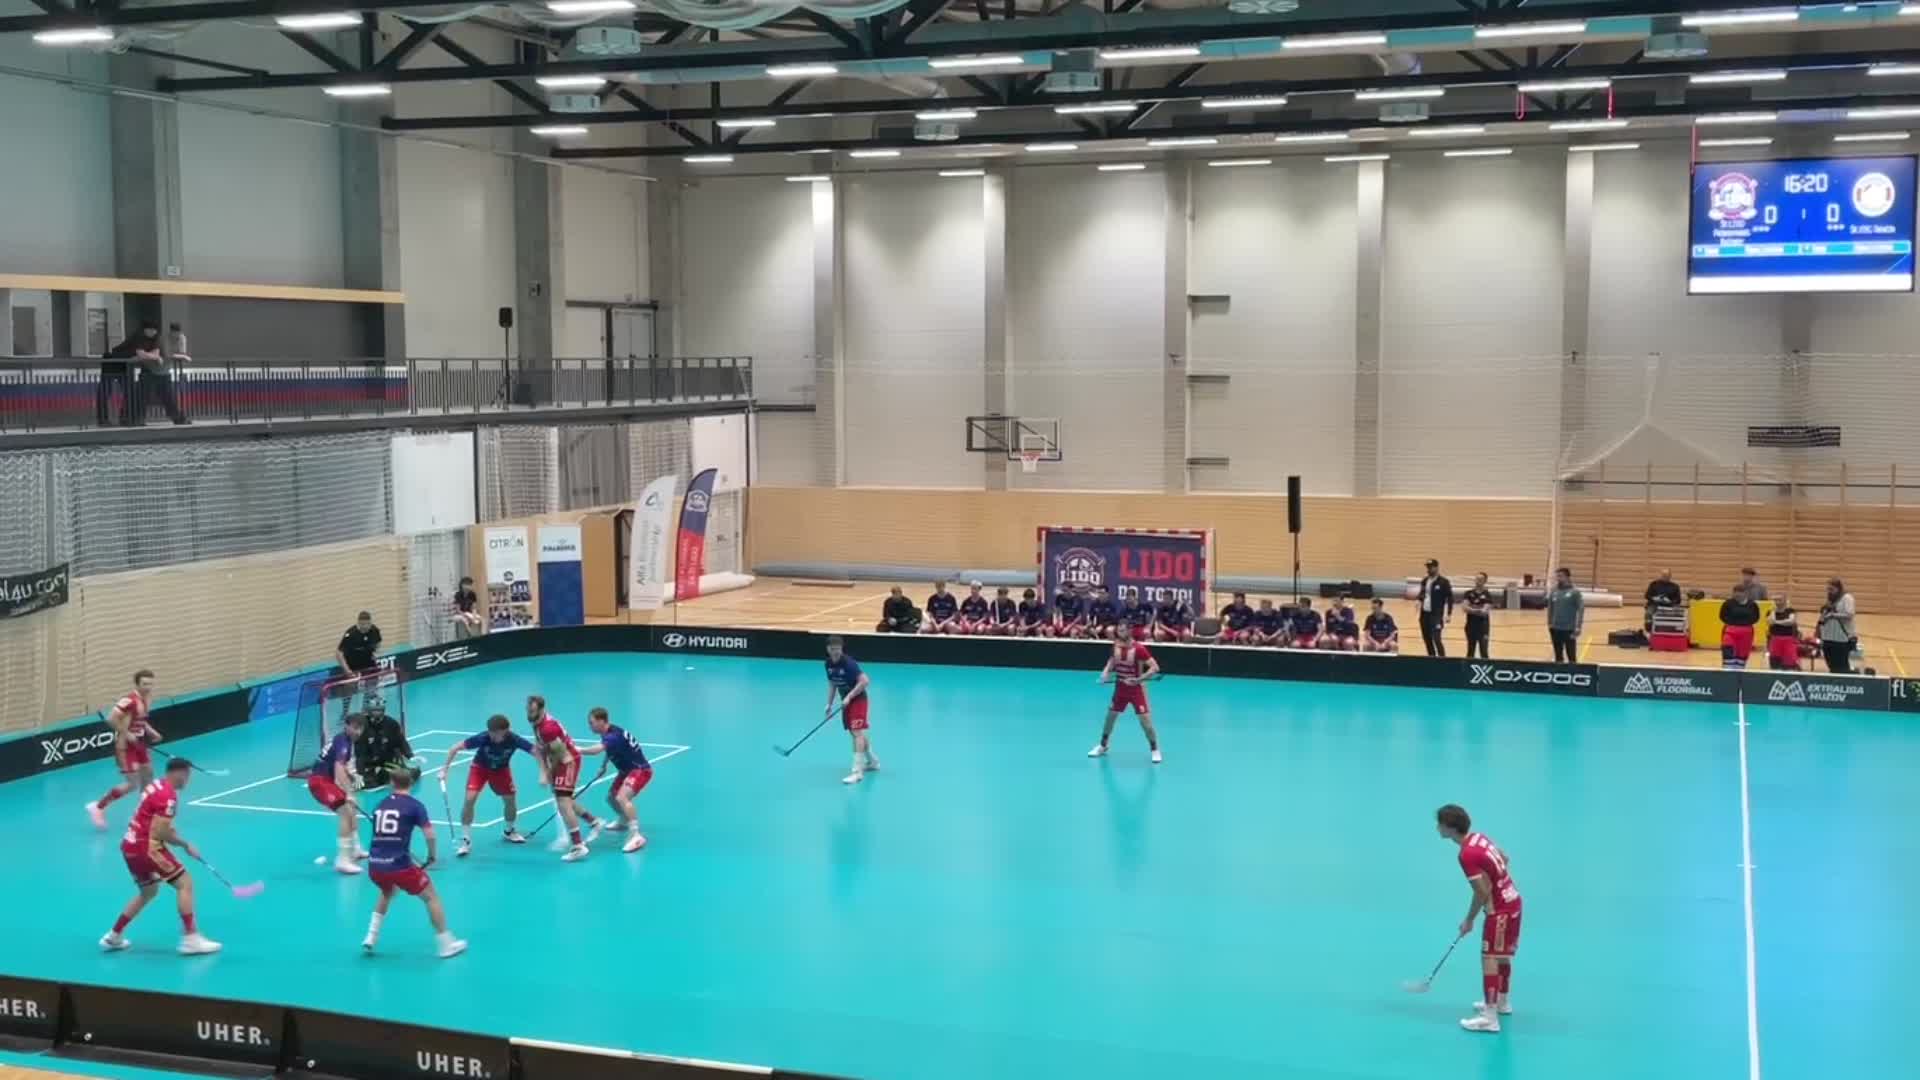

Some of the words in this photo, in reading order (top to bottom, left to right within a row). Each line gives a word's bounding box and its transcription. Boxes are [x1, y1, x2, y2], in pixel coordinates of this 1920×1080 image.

[1784, 173, 1829, 193] 16:20
[1764, 205, 1778, 225] 0
[1826, 203, 1840, 223] 0
[1119, 548, 1196, 582] LIDO
[1060, 570, 1100, 586] LIDO
[1146, 587, 1193, 604] TOO!
[688, 635, 748, 649] HYUNDAI
[1494, 669, 1592, 687] OXDOG
[1653, 676, 1693, 687] SLOVAK
[1656, 685, 1713, 696] FLOORBALL
[1807, 683, 1865, 696] EXTRALIGA
[374, 808, 400, 835] 16
